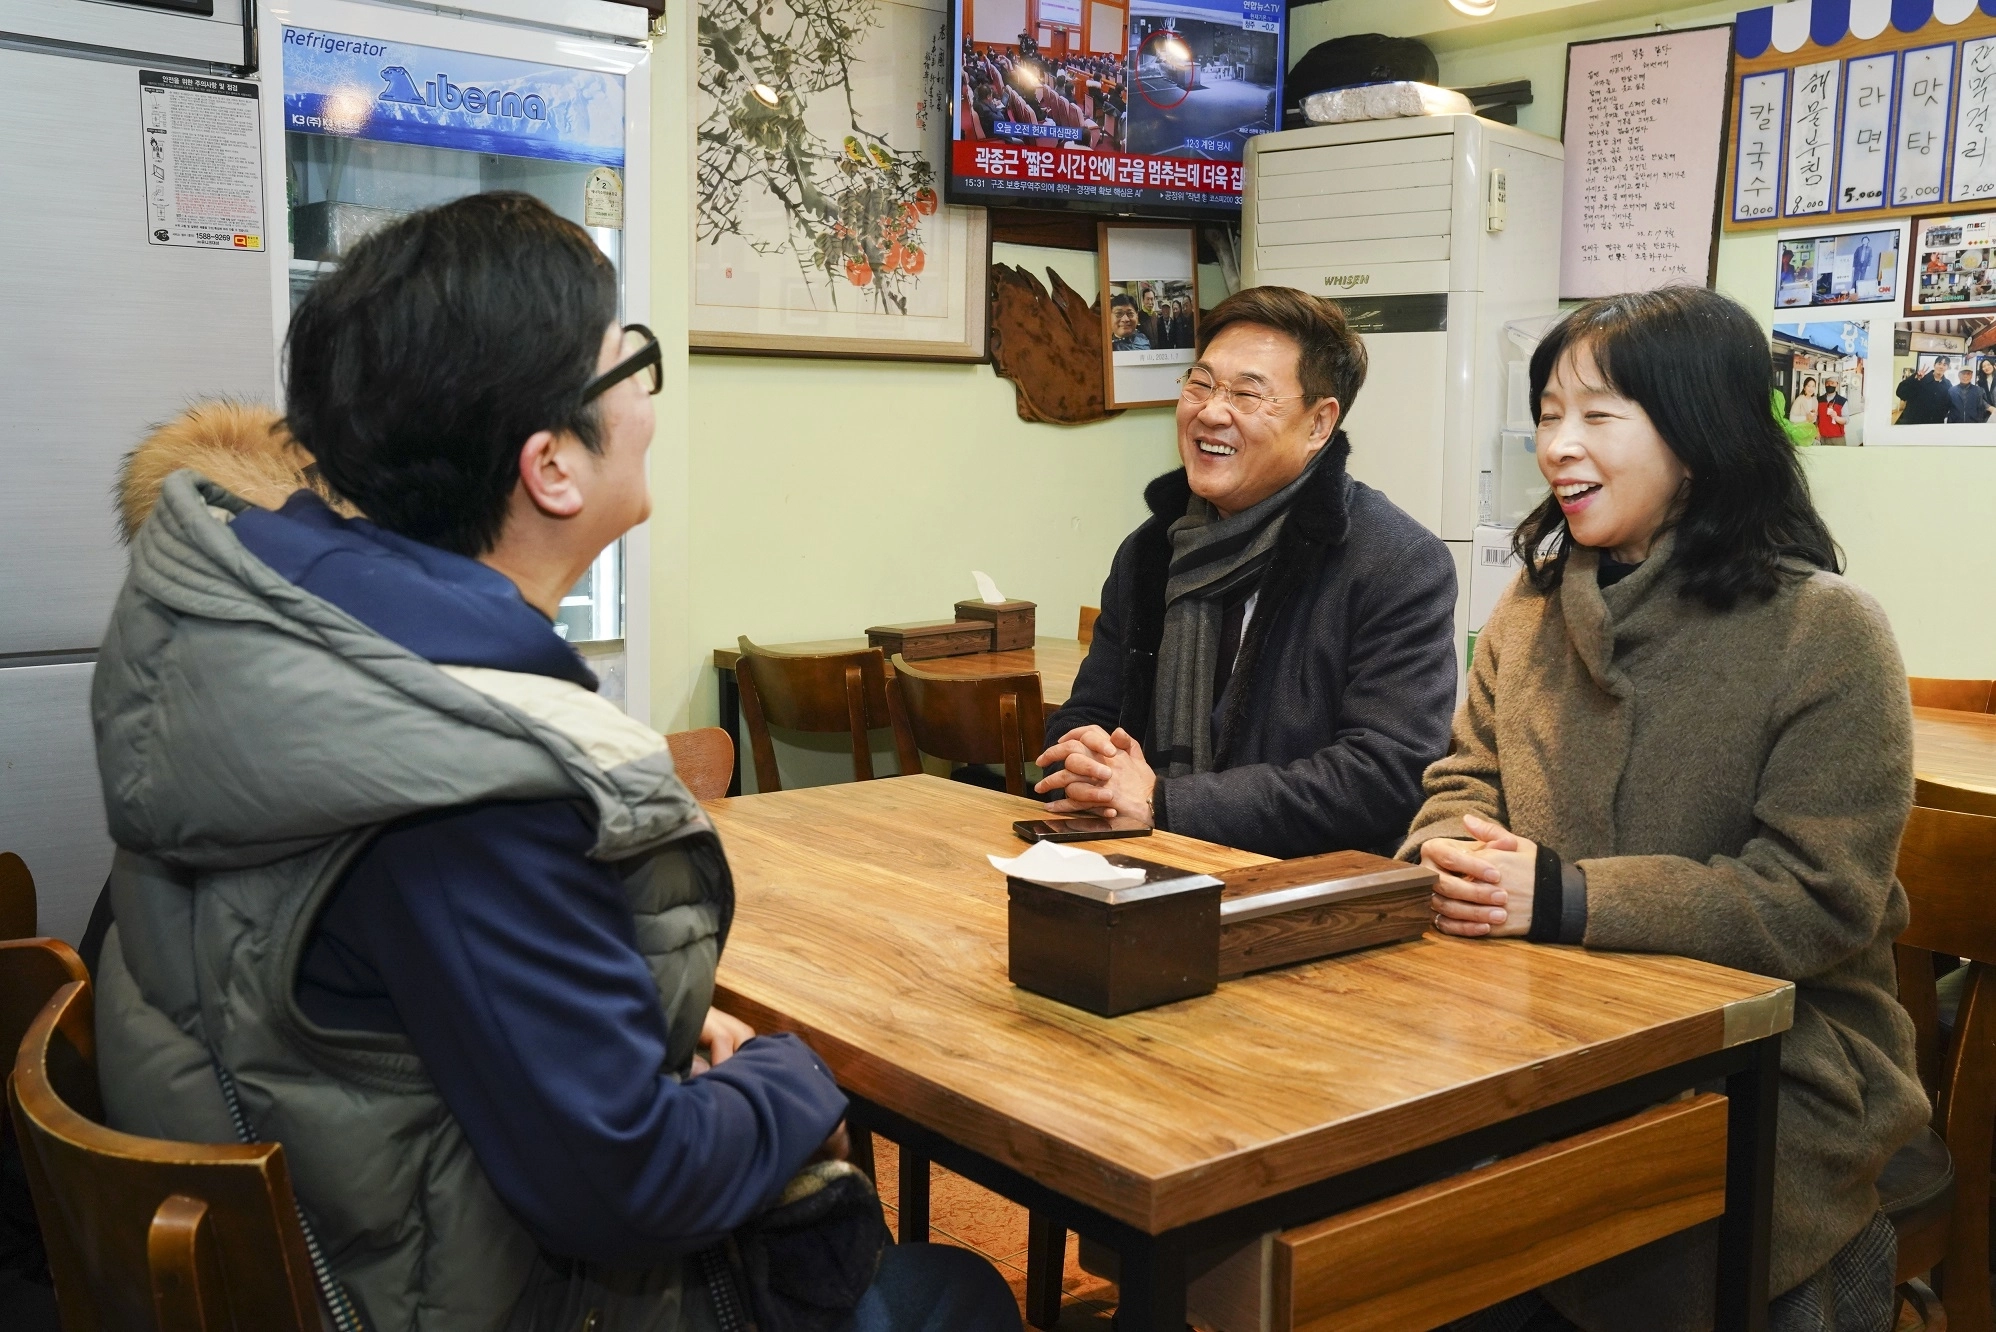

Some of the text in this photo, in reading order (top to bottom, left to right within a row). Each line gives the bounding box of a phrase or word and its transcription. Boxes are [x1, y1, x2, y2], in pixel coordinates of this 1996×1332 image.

[1243, 1, 1280, 12] 연합뉴스TV
[283, 29, 388, 57] Refrigerator
[162, 75, 180, 85] 안전을
[182, 78, 193, 86] 위한
[195, 80, 217, 90] 주의사항
[219, 83, 225, 91] 및
[227, 84, 238, 92] 점검
[1907, 77, 1943, 155] 맛탕
[1961, 45, 1996, 168] 잔막걸리
[1795, 70, 1831, 186] 해물부침
[1856, 86, 1886, 153] 라면
[996, 122, 1079, 139] 오늘 오전 헌재 대심판정
[1201, 140, 1215, 150] 계엄
[1216, 141, 1231, 151] 당시
[1743, 102, 1775, 198] 칼국수
[975, 147, 1019, 175] 곽종근
[1022, 149, 1055, 177] "짧은
[1057, 154, 1086, 179] 시간
[1088, 155, 1116, 182] 안에
[1118, 158, 1146, 184] 군을
[1149, 160, 1200, 188] 멈추는데
[1203, 164, 1228, 190] 더욱
[965, 179, 985, 188] 15:31
[991, 179, 1004, 189] 구조
[1006, 180, 1054, 193] 보호무역주의에
[1098, 186, 1112, 196] 확보
[1113, 188, 1133, 198] 핵심은
[196, 232, 231, 242] 1588-9269
[1324, 275, 1370, 287] WHISEN
